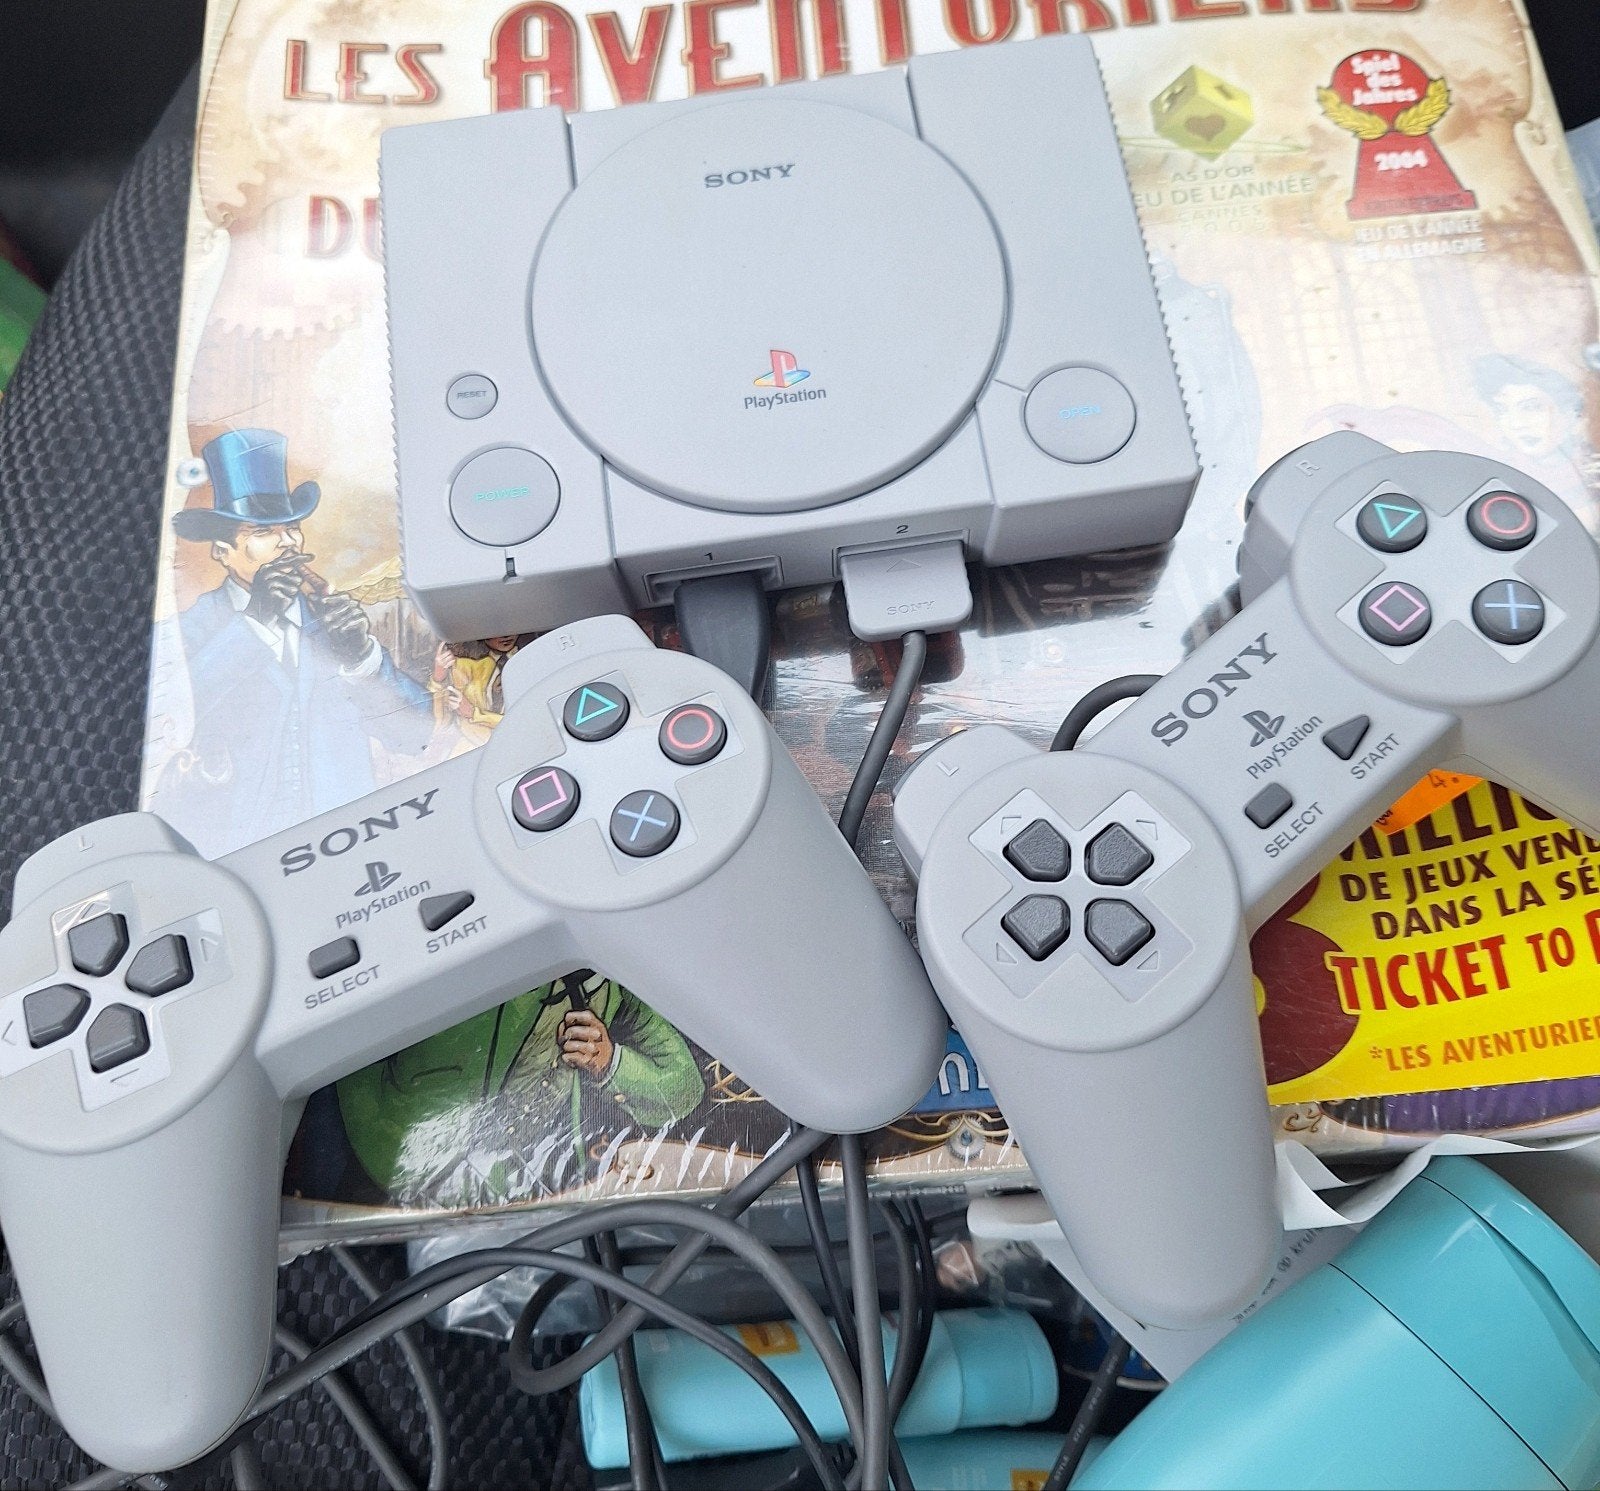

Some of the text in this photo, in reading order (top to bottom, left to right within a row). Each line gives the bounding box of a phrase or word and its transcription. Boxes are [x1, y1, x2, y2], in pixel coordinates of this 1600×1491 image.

[283, 0, 1425, 114] LES AVENTU
[1350, 53, 1401, 77] Spiel
[1366, 73, 1403, 88] des
[704, 163, 796, 189] SONY
[1170, 165, 1255, 184] AS D'OR
[1373, 149, 1429, 172] 2004
[1131, 174, 1315, 207] EU DE L'ANNÉE
[456, 390, 488, 400] RESET
[743, 387, 827, 410] PlayStation
[1058, 404, 1102, 420] OPEN
[473, 486, 529, 504] POWER
[896, 524, 909, 534] 2
[704, 552, 714, 561] 1
[886, 600, 936, 616] SONY
[1150, 631, 1278, 748] SONY
[1245, 713, 1324, 780] PlayStation
[1350, 732, 1401, 780] START
[279, 787, 440, 877] SONY
[1264, 801, 1325, 859] SELECT
[1339, 870, 1392, 902] DE
[1403, 850, 1497, 905] JEUX
[335, 879, 432, 929] PlayStation
[1370, 857, 1600, 941] DANS LA SÉ
[426, 914, 488, 954] START
[1331, 933, 1512, 1013] TICKET
[1525, 926, 1576, 974] TO
[303, 964, 381, 1010] SELECT
